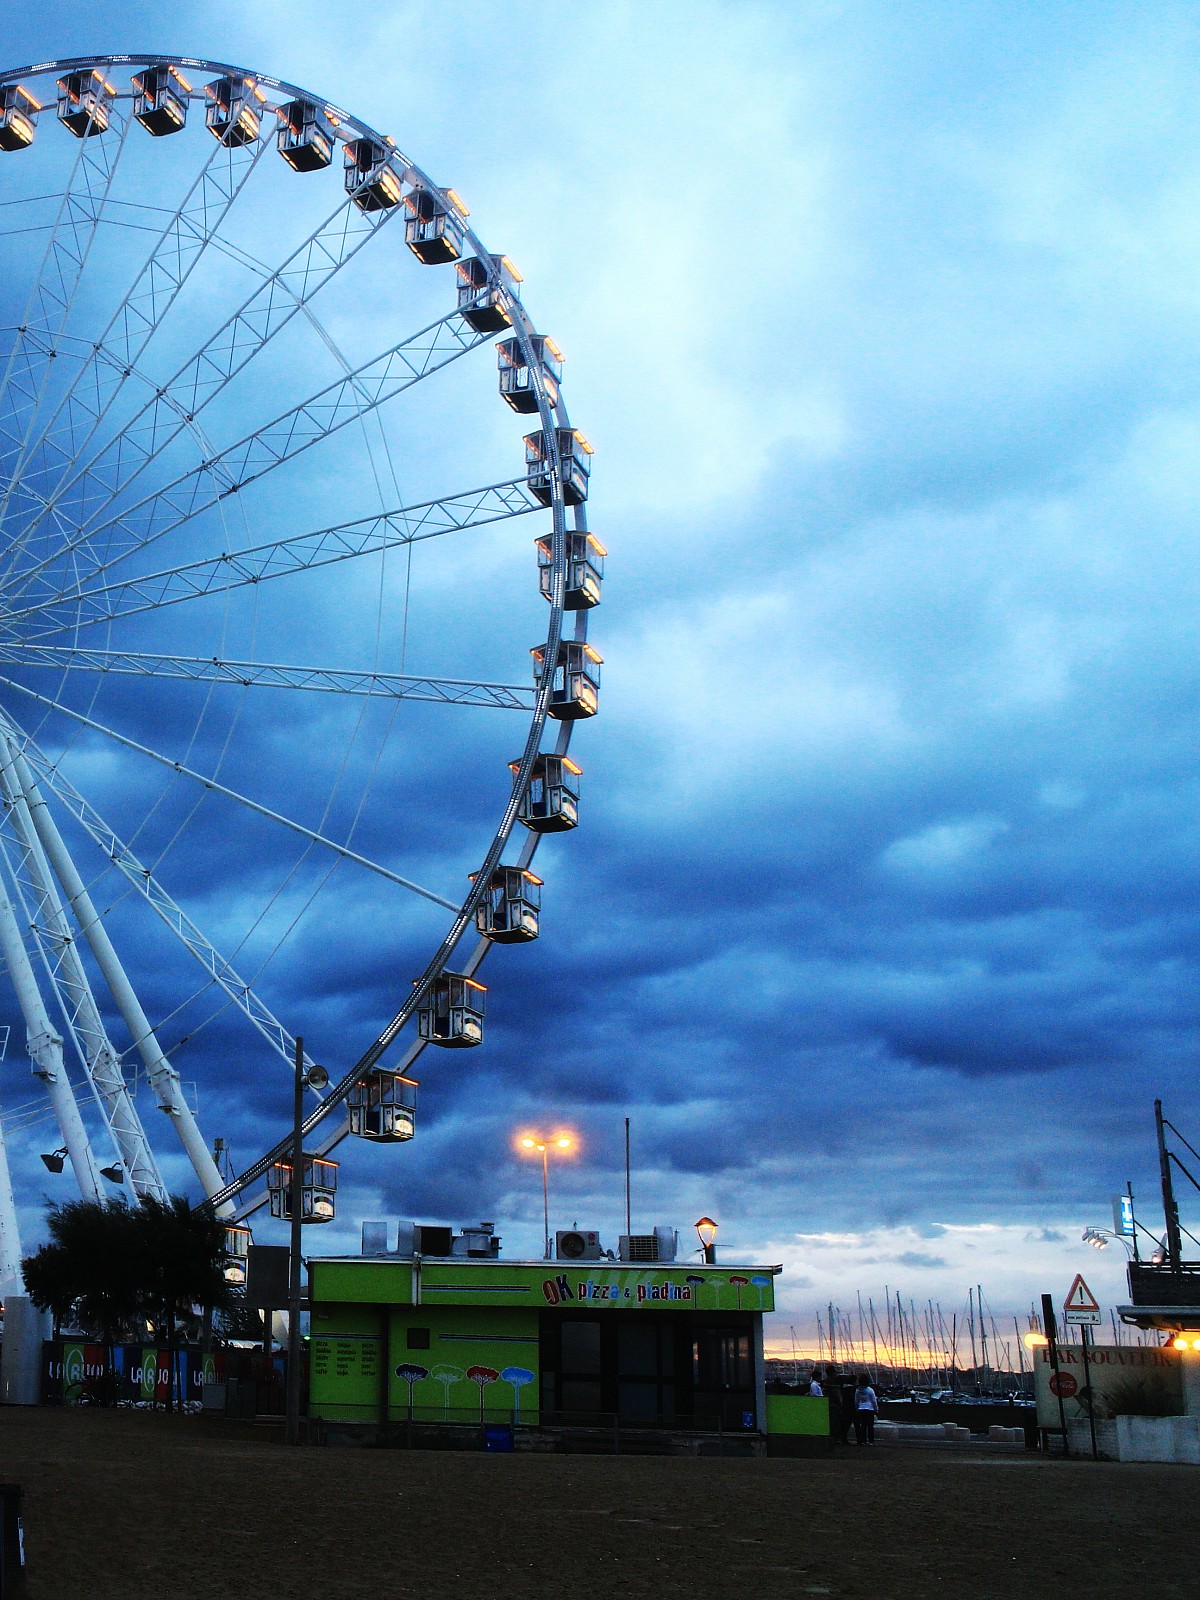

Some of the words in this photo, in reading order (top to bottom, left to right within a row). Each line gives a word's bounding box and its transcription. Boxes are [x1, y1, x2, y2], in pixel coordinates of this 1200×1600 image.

[542, 1274, 575, 1305] OK
[578, 1280, 619, 1300] pizza
[624, 1288, 630, 1298] &
[637, 1281, 691, 1302] piadina
[131, 1366, 143, 1384] LA
[193, 1370, 204, 1387] LA
